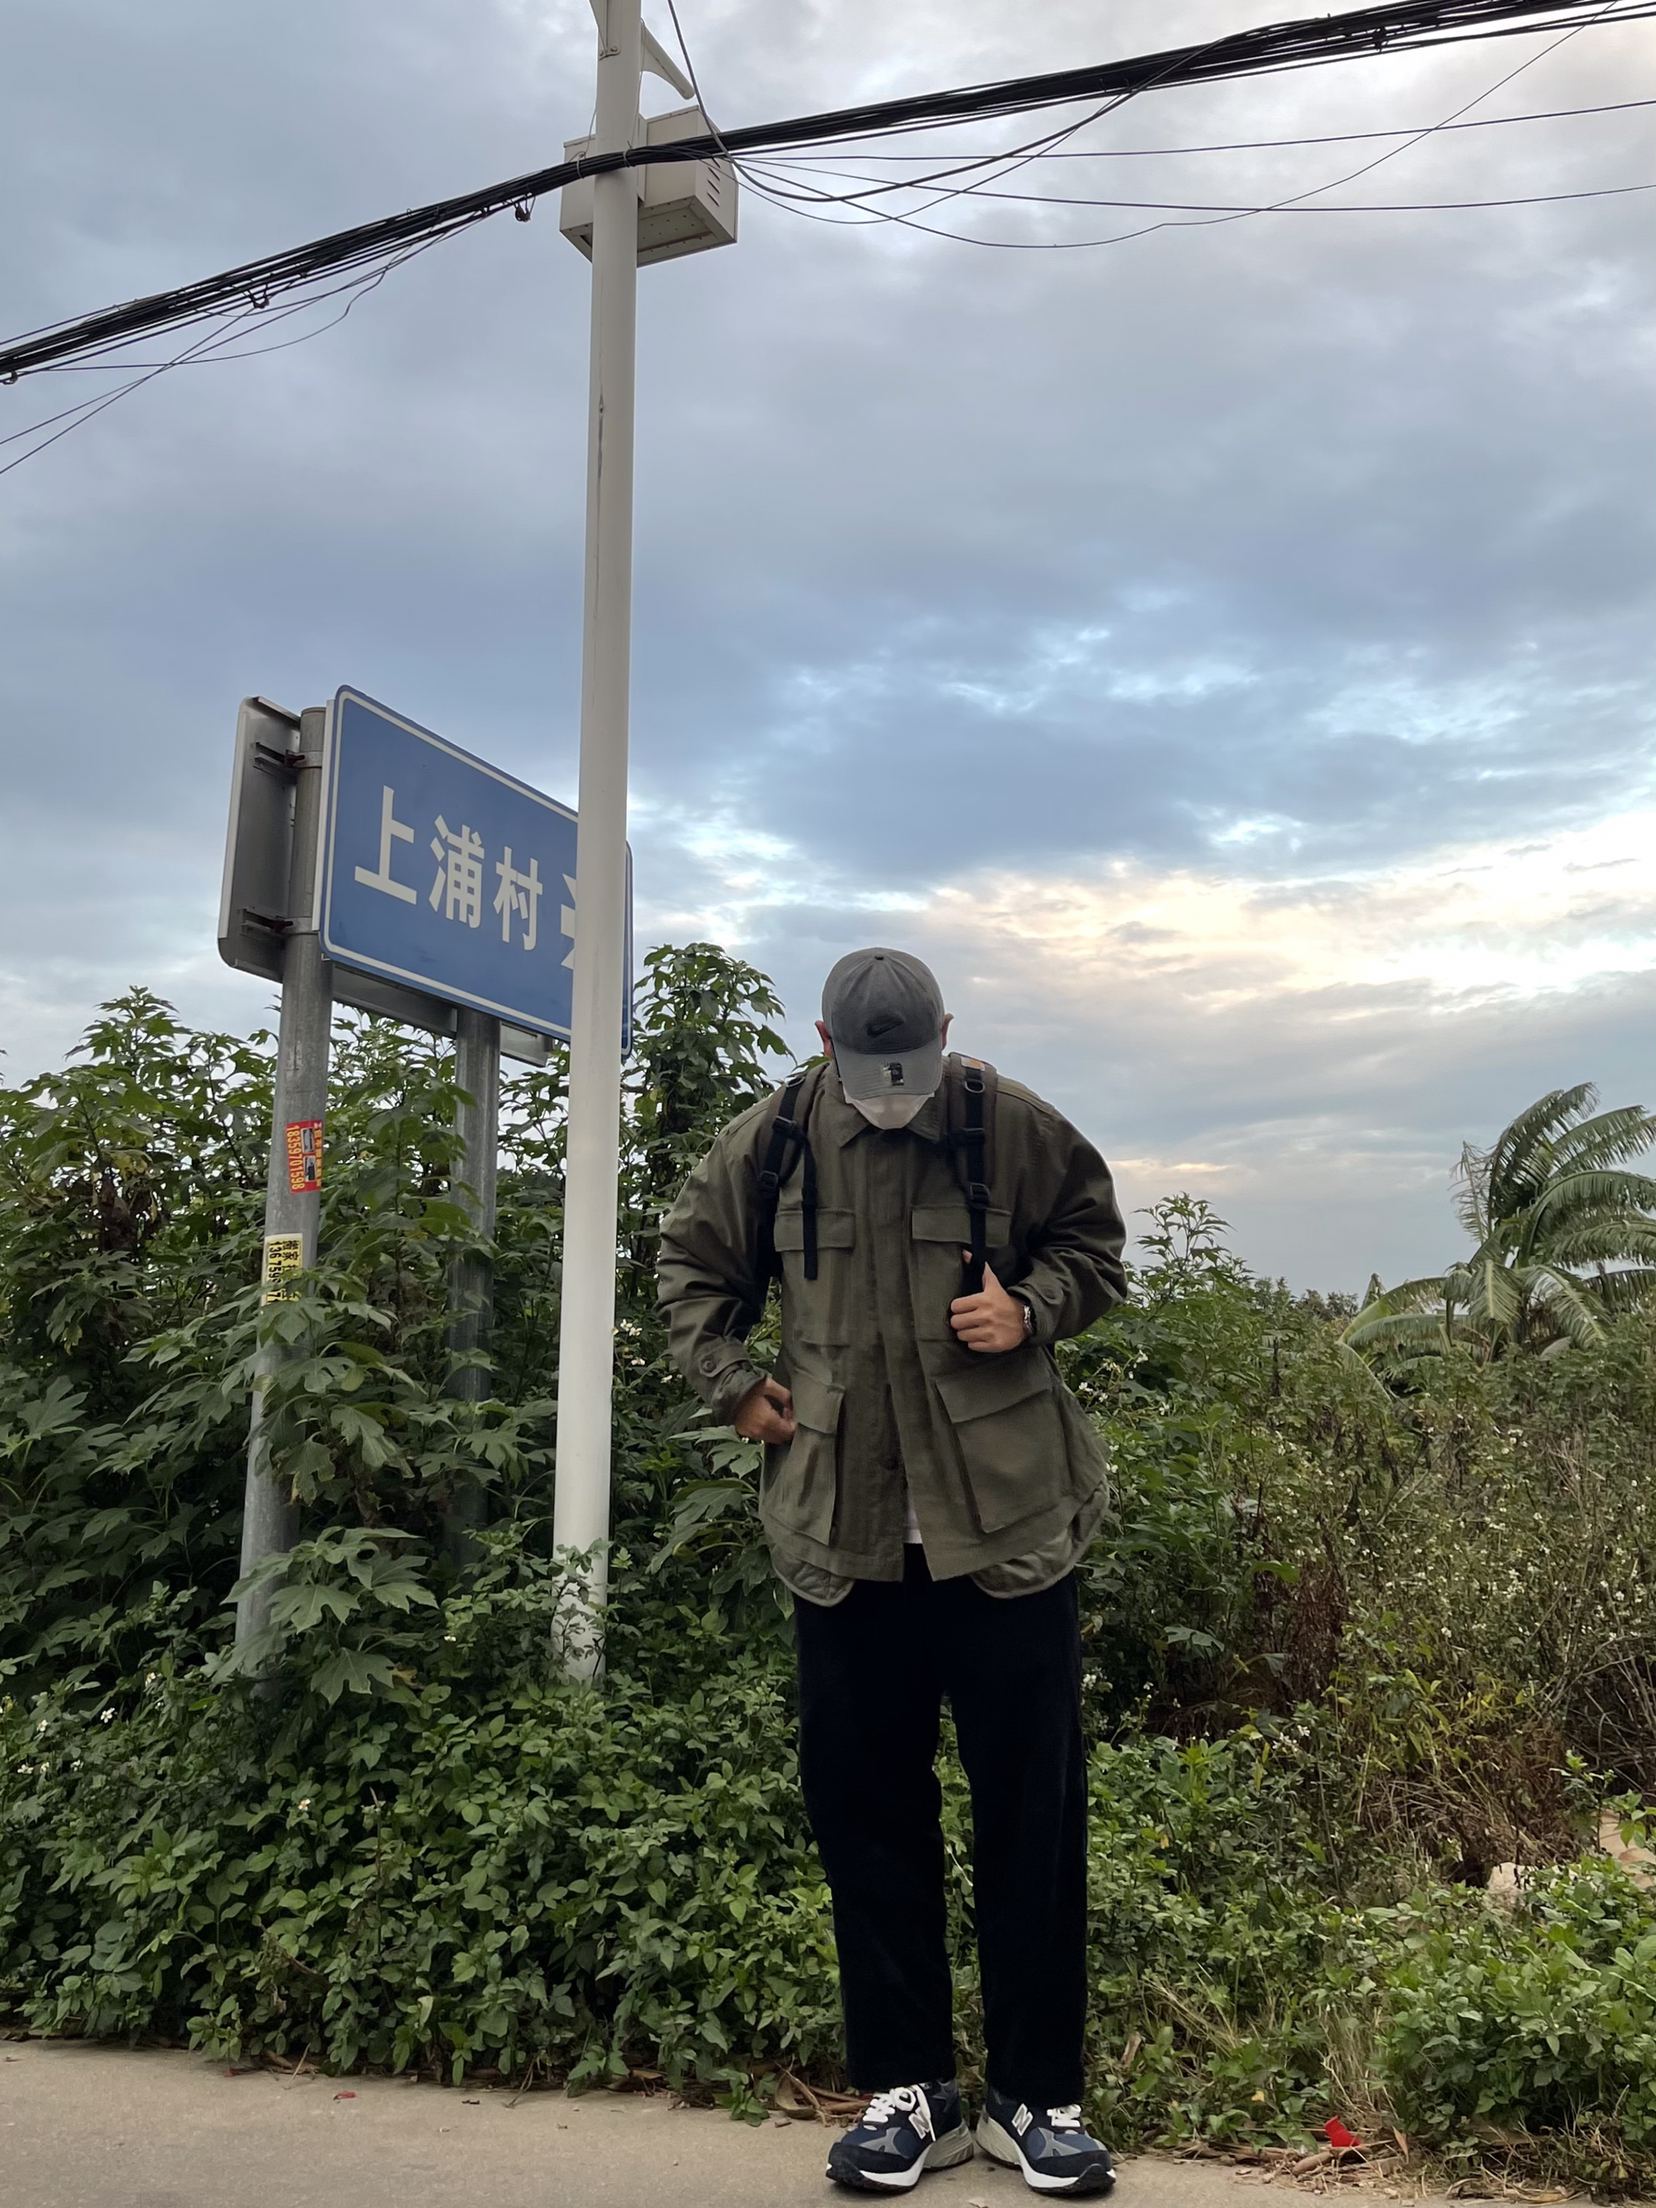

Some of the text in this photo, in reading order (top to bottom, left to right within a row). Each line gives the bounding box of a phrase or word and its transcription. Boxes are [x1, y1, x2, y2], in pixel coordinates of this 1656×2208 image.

[355, 785, 543, 951] 上浦村
[286, 1125, 306, 1190] 18359701598
[1011, 2102, 1034, 2136] N
